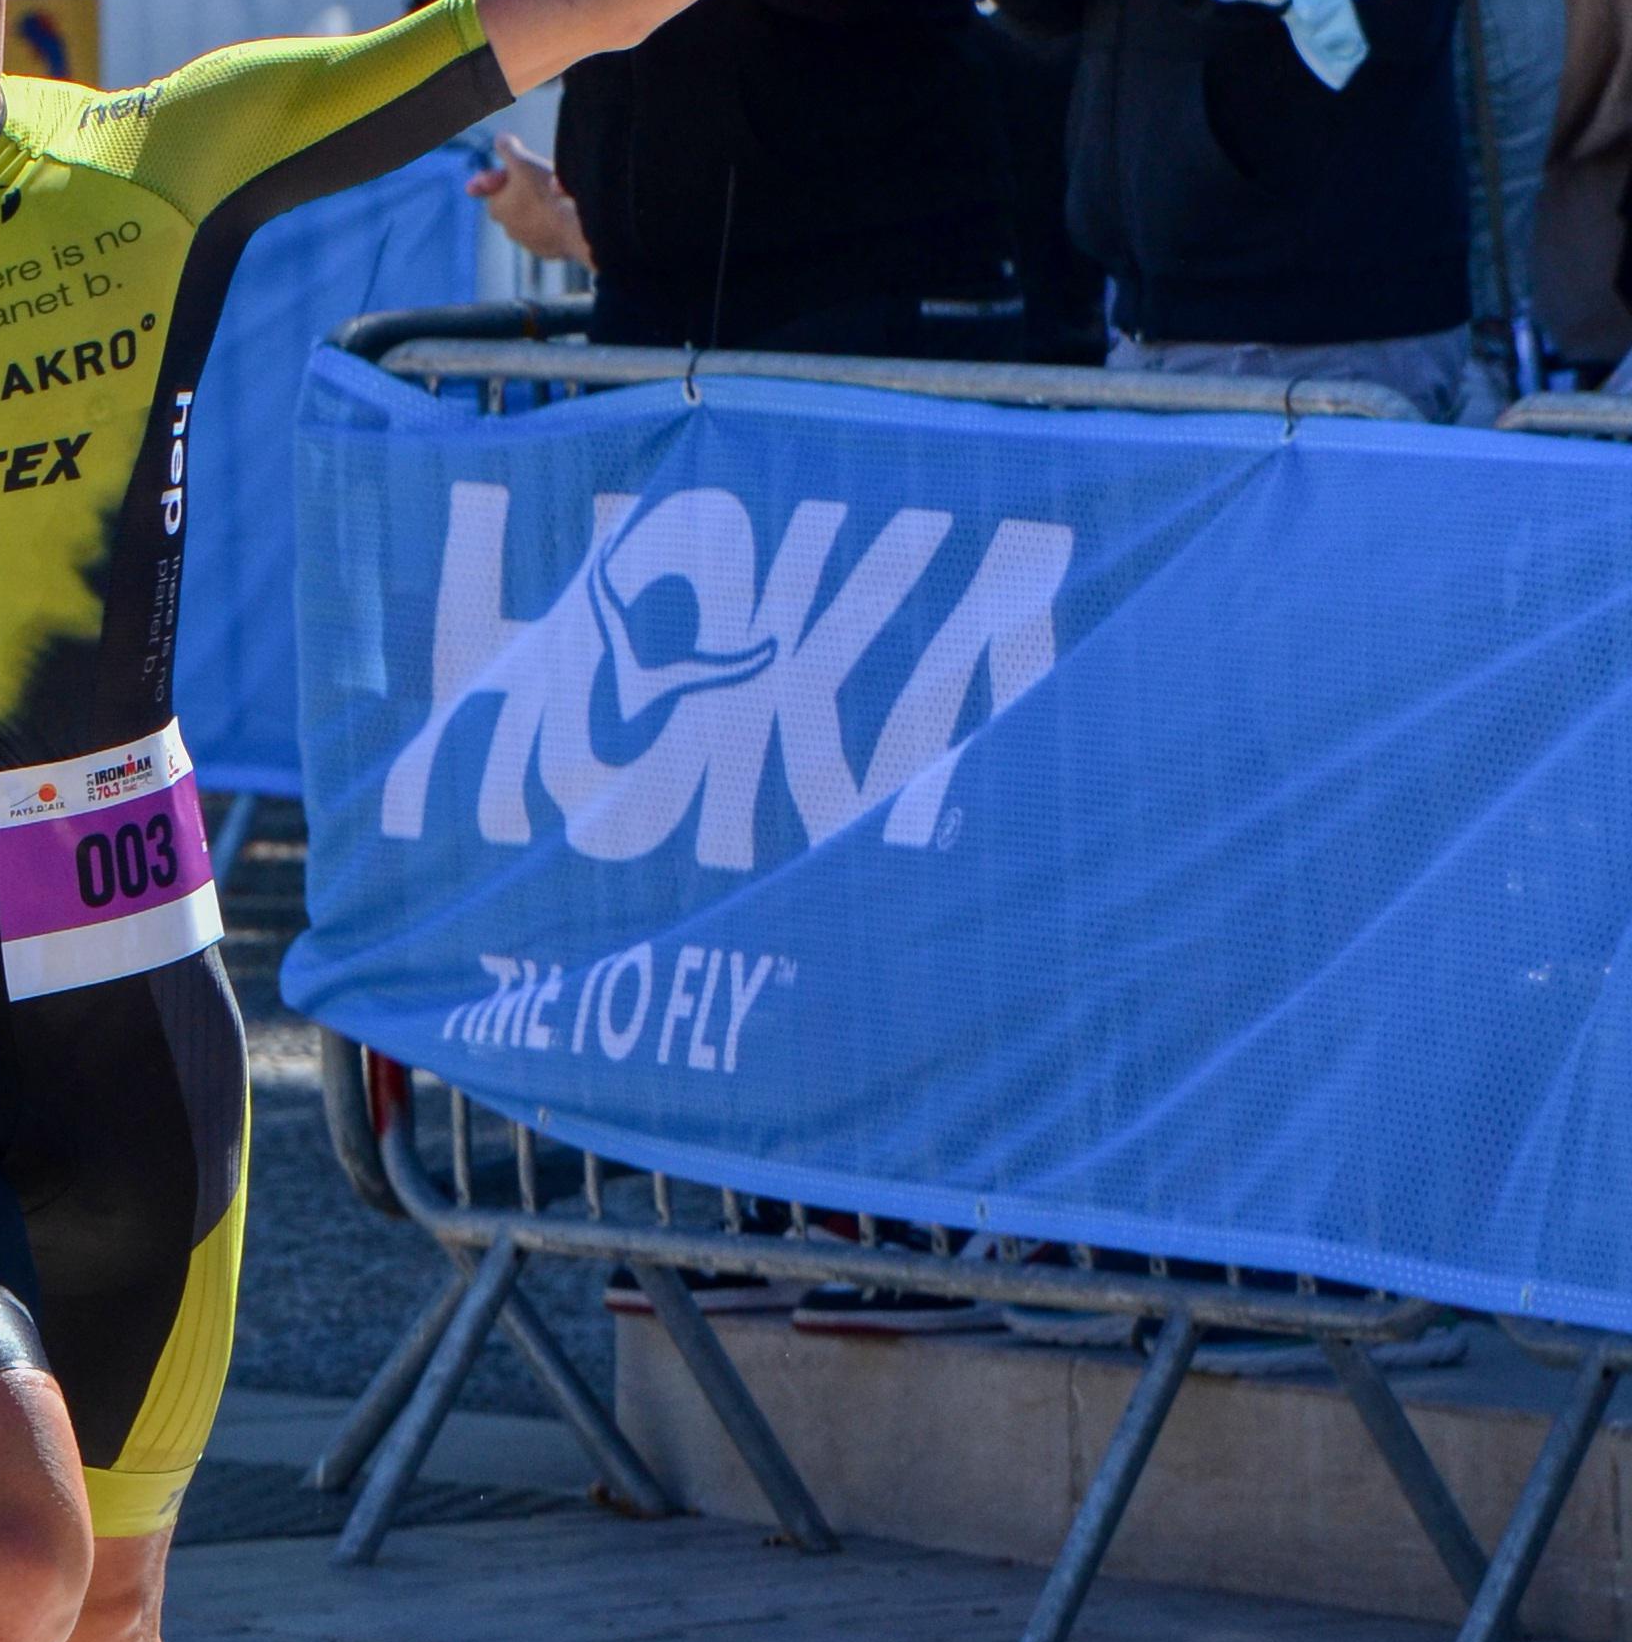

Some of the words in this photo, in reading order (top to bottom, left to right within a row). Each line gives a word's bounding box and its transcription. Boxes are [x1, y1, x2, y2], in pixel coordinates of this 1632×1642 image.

[51, 245, 85, 271] is
[94, 220, 142, 255] no
[84, 272, 123, 299] b.
[161, 390, 194, 535] hep
[147, 559, 169, 644] planet
[380, 479, 1074, 870] HOKA
[86, 773, 97, 803] 2021
[95, 755, 153, 785] IRONMAN
[96, 782, 121, 801] 70.3
[75, 813, 179, 908] 003
[657, 945, 774, 1074] FLY
